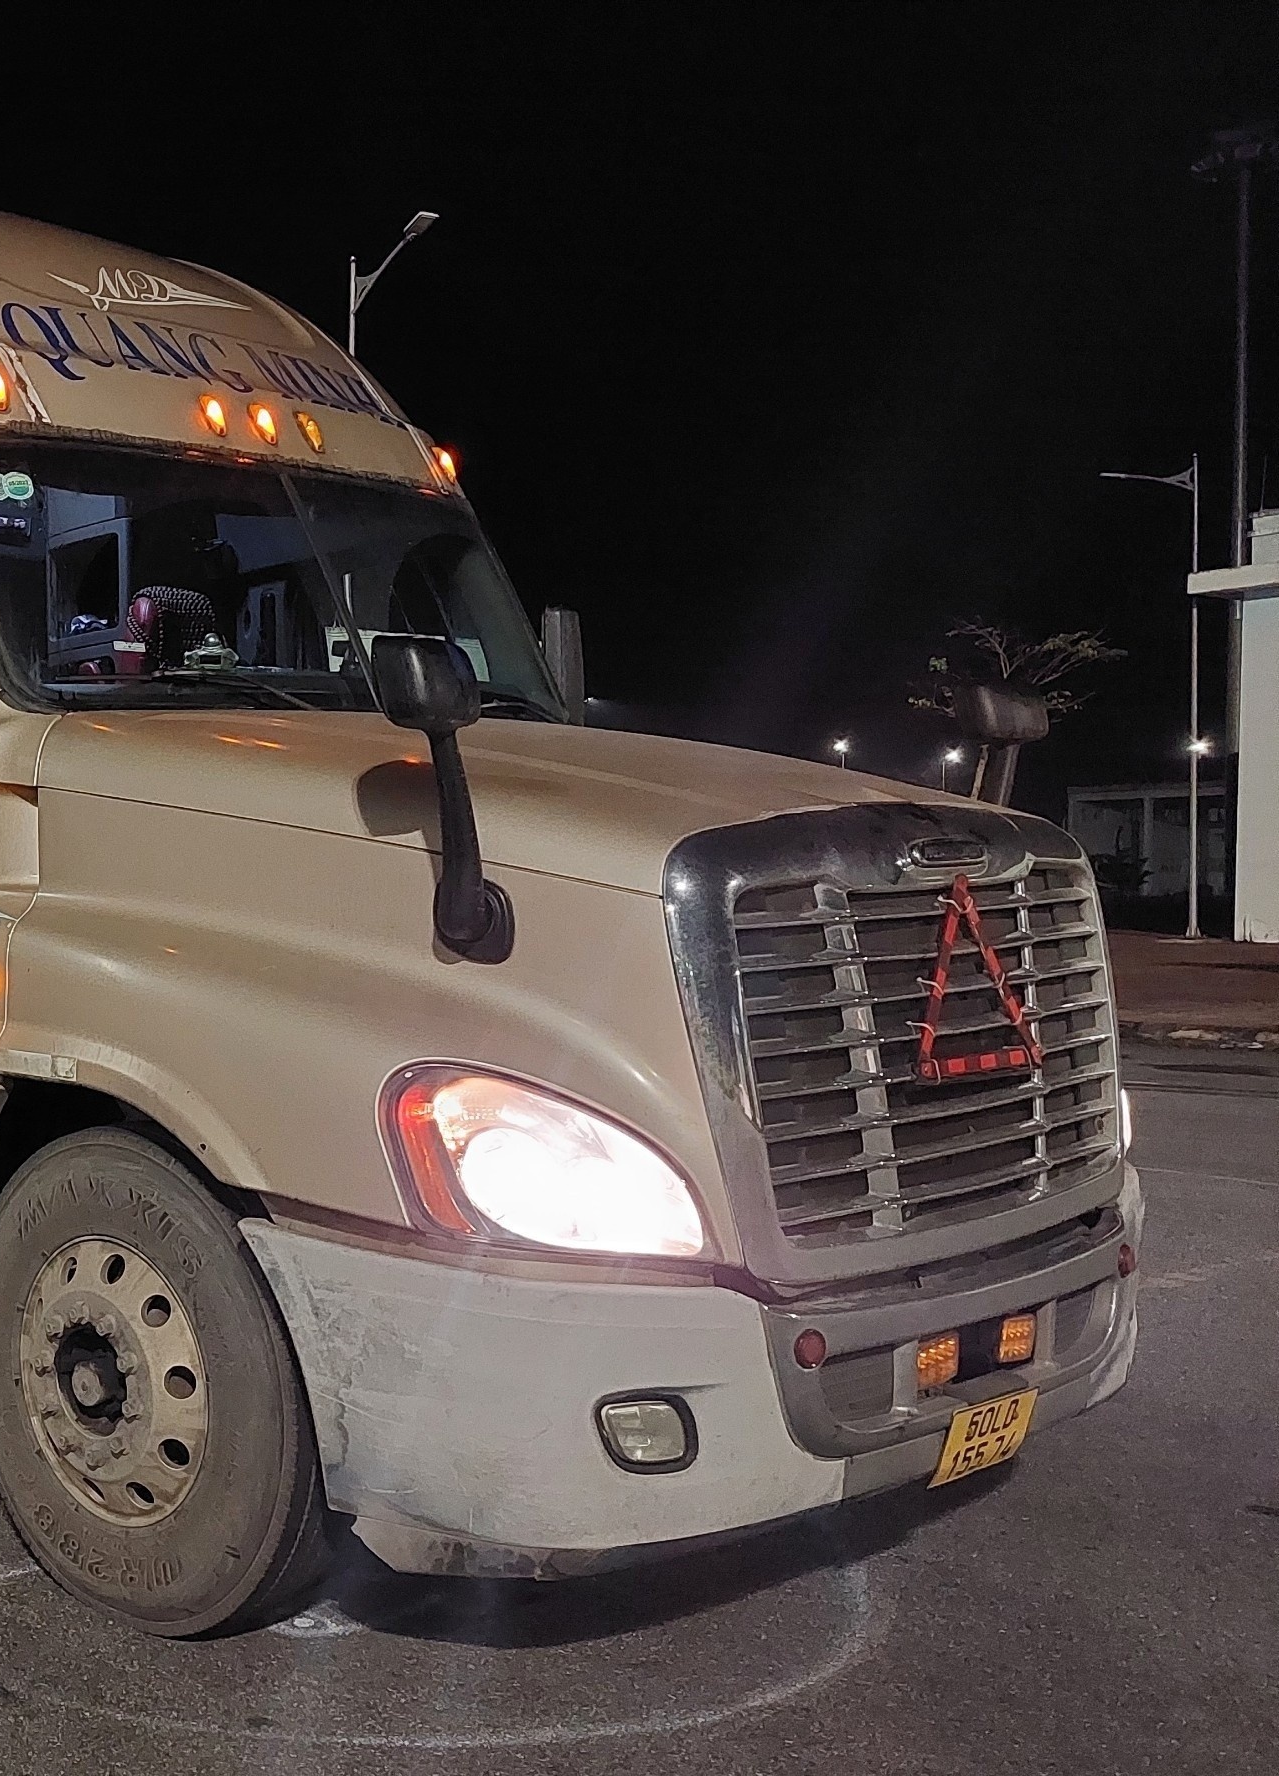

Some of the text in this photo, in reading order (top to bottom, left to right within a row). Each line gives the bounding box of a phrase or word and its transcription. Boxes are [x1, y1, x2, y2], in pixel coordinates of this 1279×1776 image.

[2, 302, 410, 432] QUANG MINH
[964, 1398, 1020, 1443] 50LD
